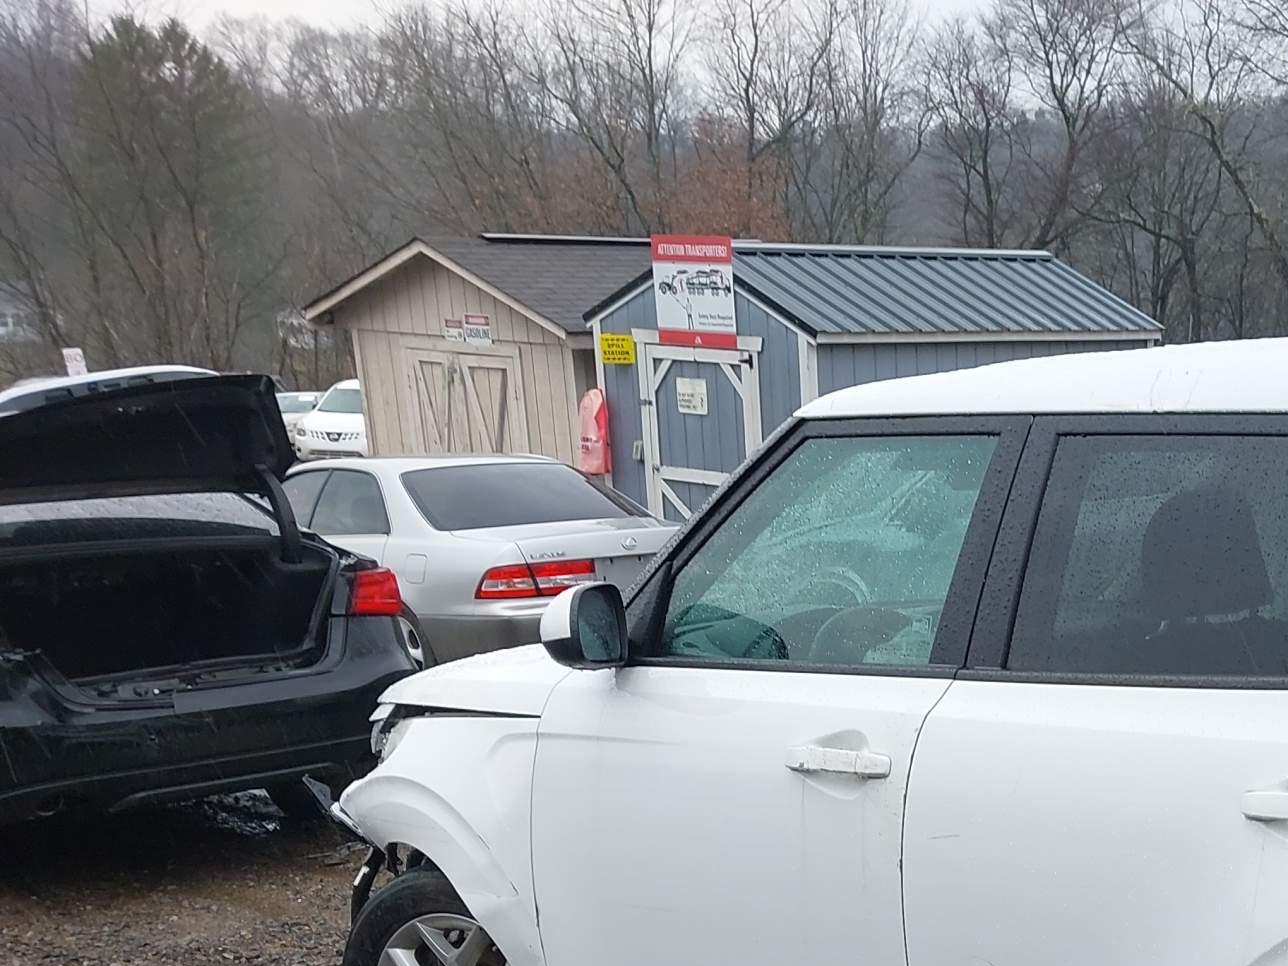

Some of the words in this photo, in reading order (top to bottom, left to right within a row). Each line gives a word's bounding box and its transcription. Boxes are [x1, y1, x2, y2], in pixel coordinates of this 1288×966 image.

[658, 243, 685, 256] ATTENTION
[685, 244, 728, 257] TRANSPORTERS!
[465, 327, 490, 339] GASOLINE
